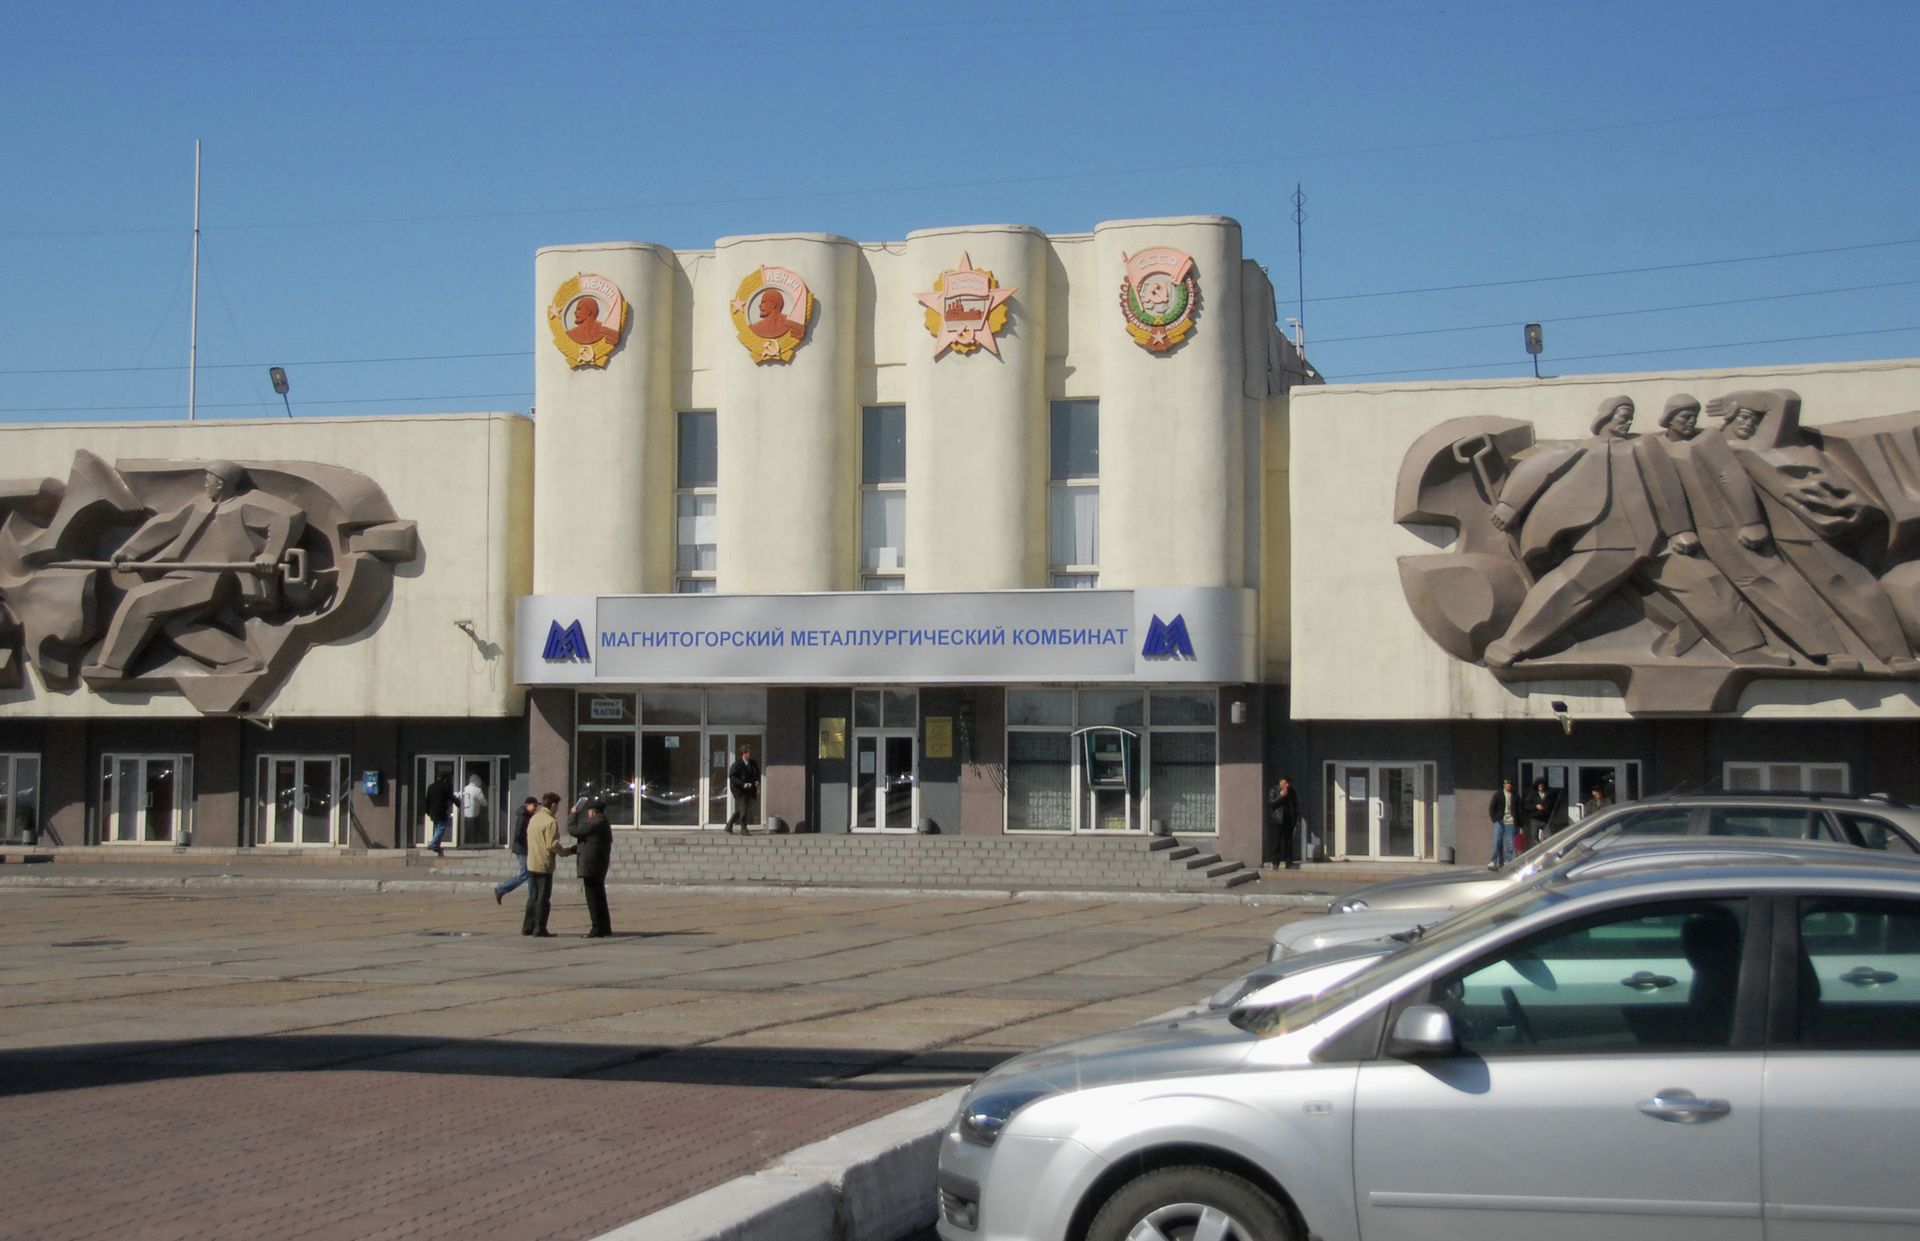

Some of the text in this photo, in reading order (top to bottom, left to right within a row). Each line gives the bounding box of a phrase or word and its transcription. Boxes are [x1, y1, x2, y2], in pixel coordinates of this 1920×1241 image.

[582, 278, 616, 300] ЛЕНИН
[766, 270, 800, 293] ЛЕНИН
[602, 625, 1126, 647] МАГНИТОГОРСКИЙ МЕТАЛЛУРГИЧЕСКИЙ КОМБИНАТ
